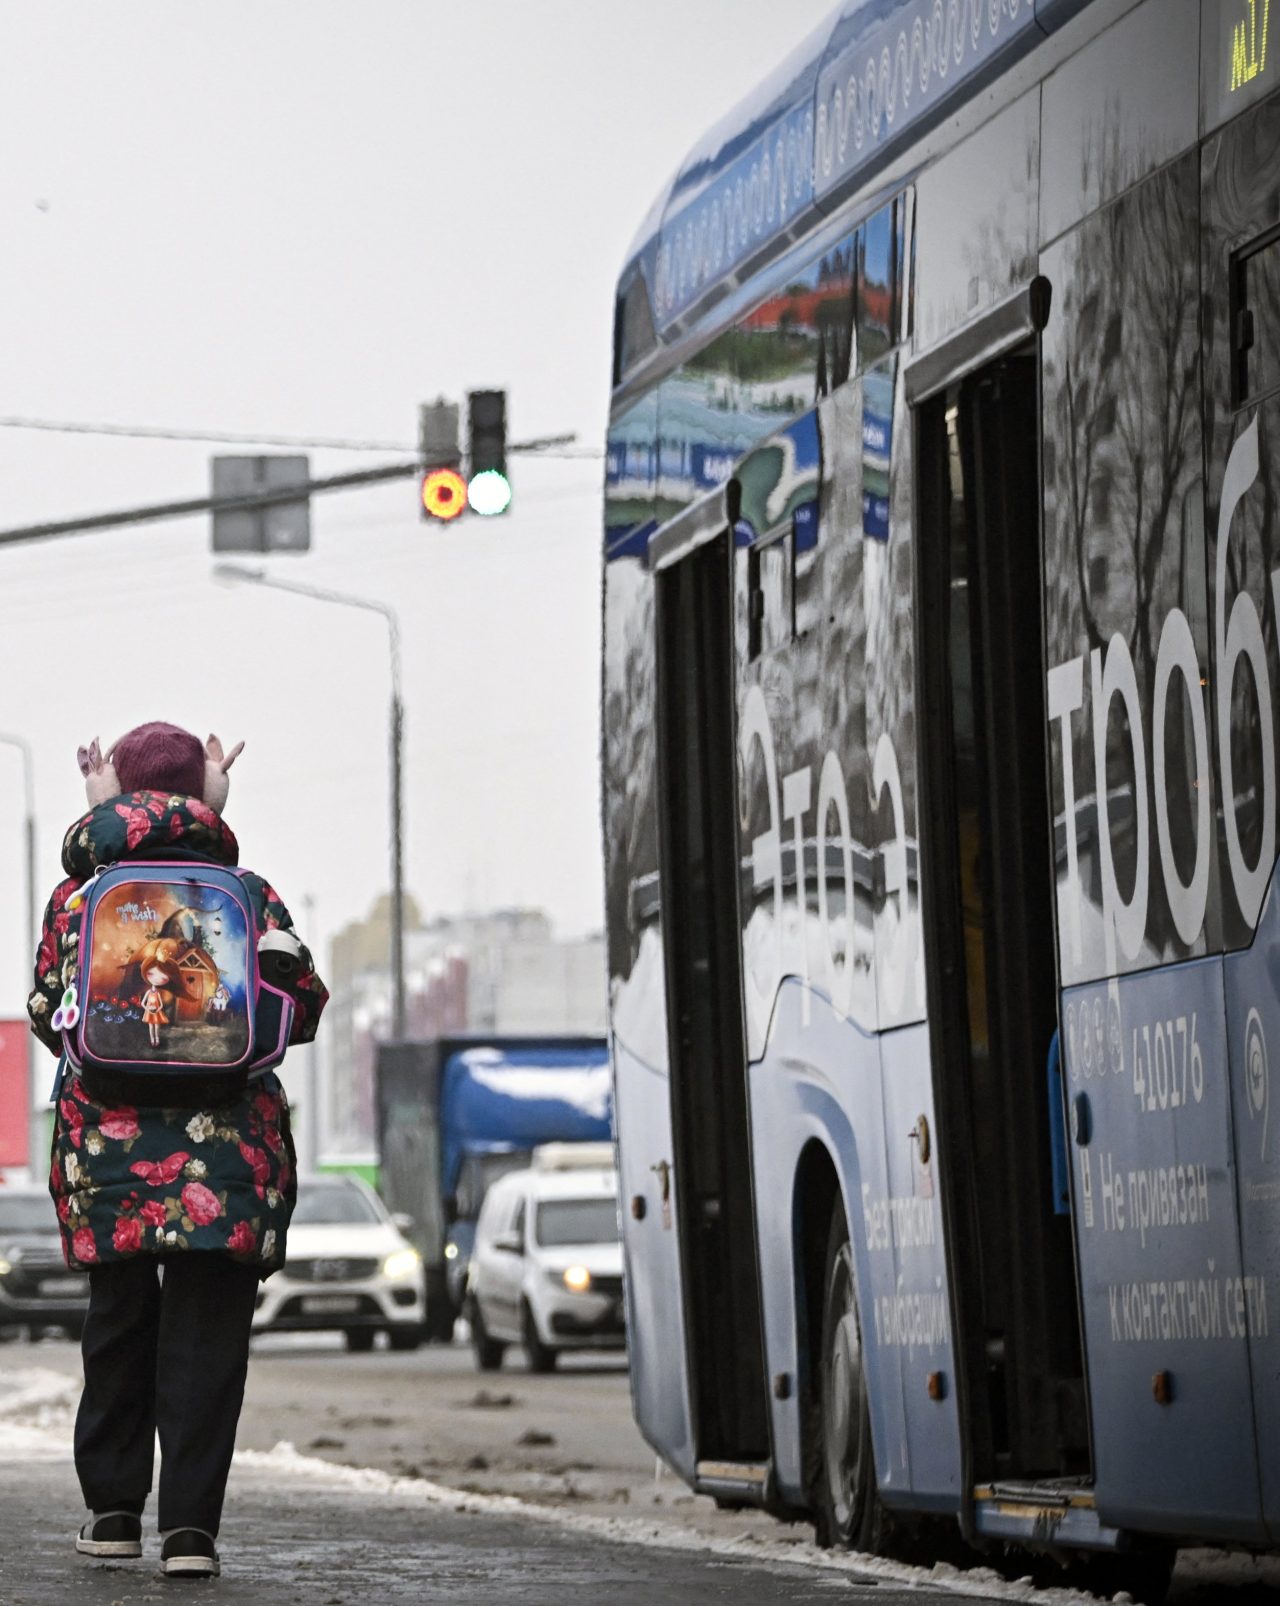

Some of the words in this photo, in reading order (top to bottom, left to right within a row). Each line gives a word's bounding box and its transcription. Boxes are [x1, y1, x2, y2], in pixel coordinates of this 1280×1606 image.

[1048, 410, 1280, 1072] троб
[1133, 1012, 1203, 1112] 410176
[1100, 1153, 1125, 1232] Не
[1128, 1163, 1209, 1249] привязан
[1108, 1285, 1120, 1342] к
[1121, 1256, 1222, 1341] контактной
[1225, 1275, 1269, 1337] сети
